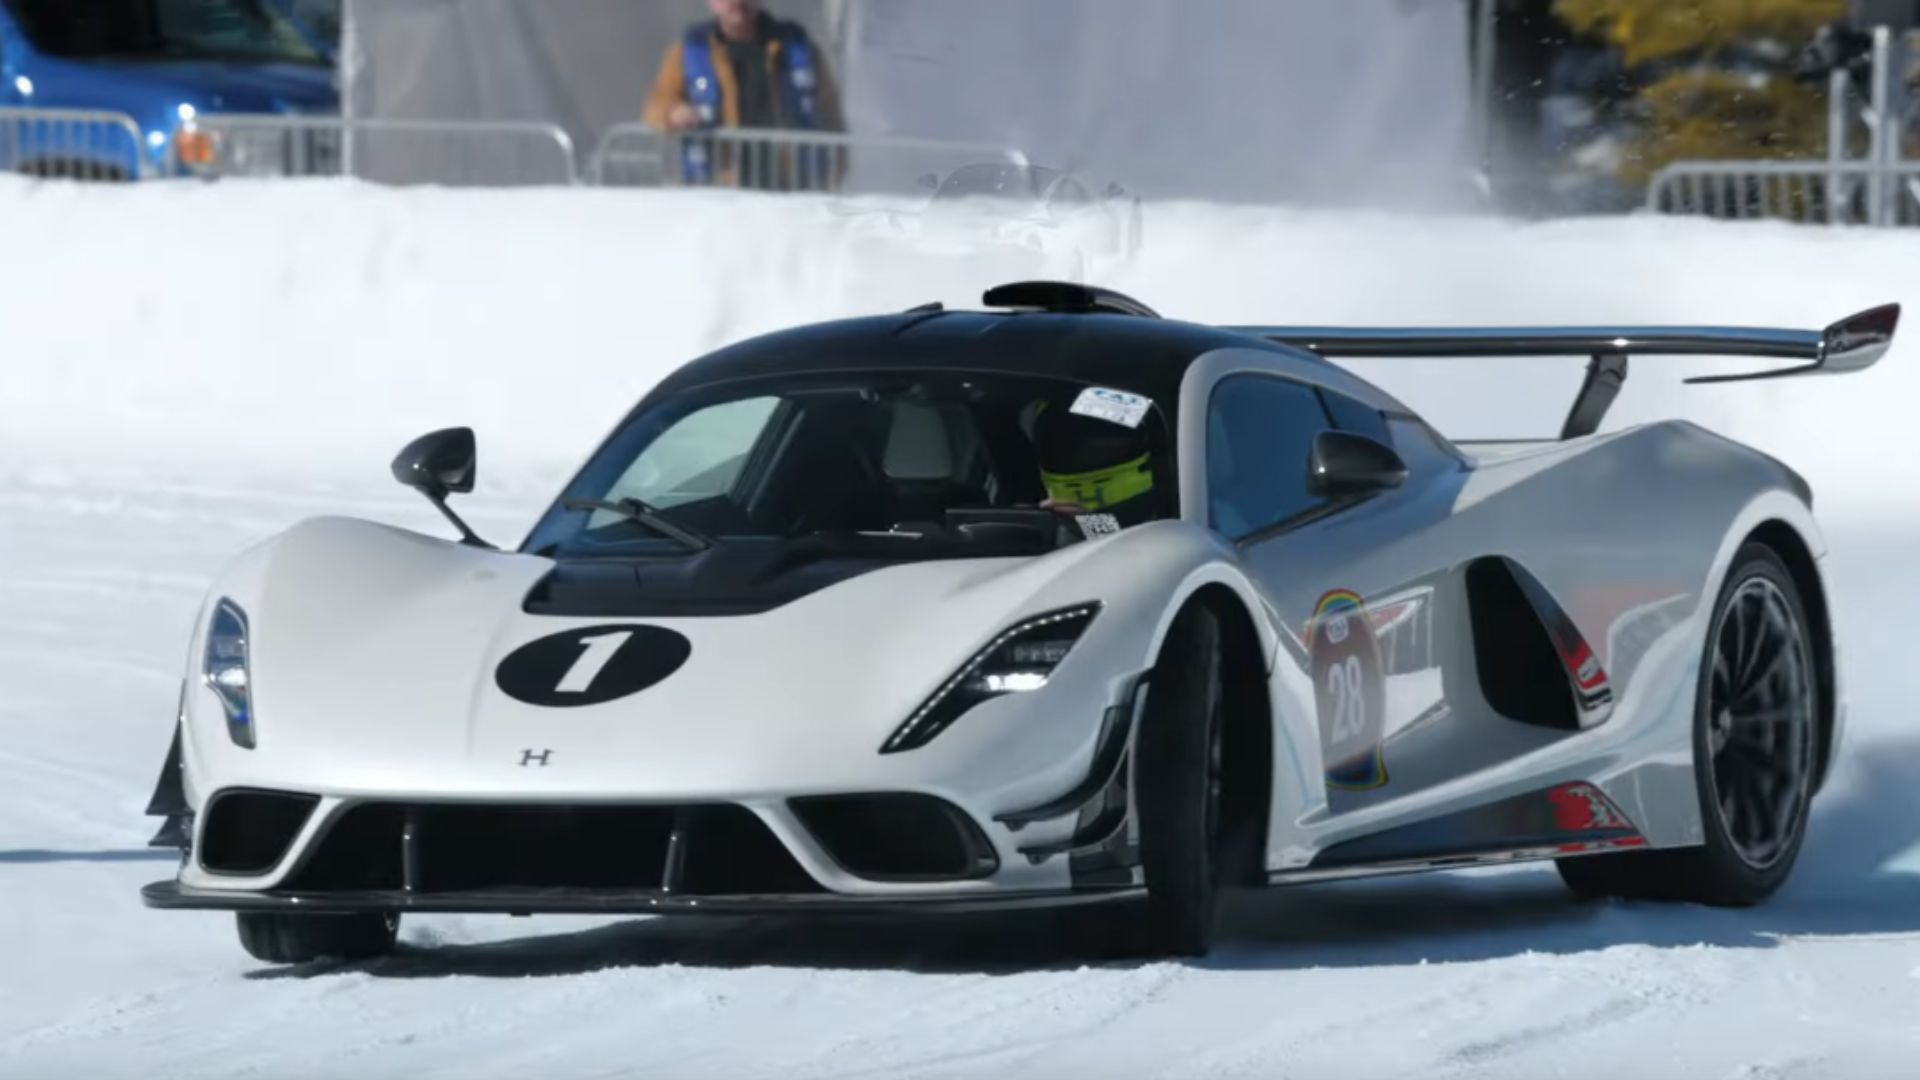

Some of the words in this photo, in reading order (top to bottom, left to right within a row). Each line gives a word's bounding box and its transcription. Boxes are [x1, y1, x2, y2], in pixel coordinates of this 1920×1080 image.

[554, 630, 634, 692] 1
[1327, 655, 1366, 745] 28
[517, 749, 555, 767] H
